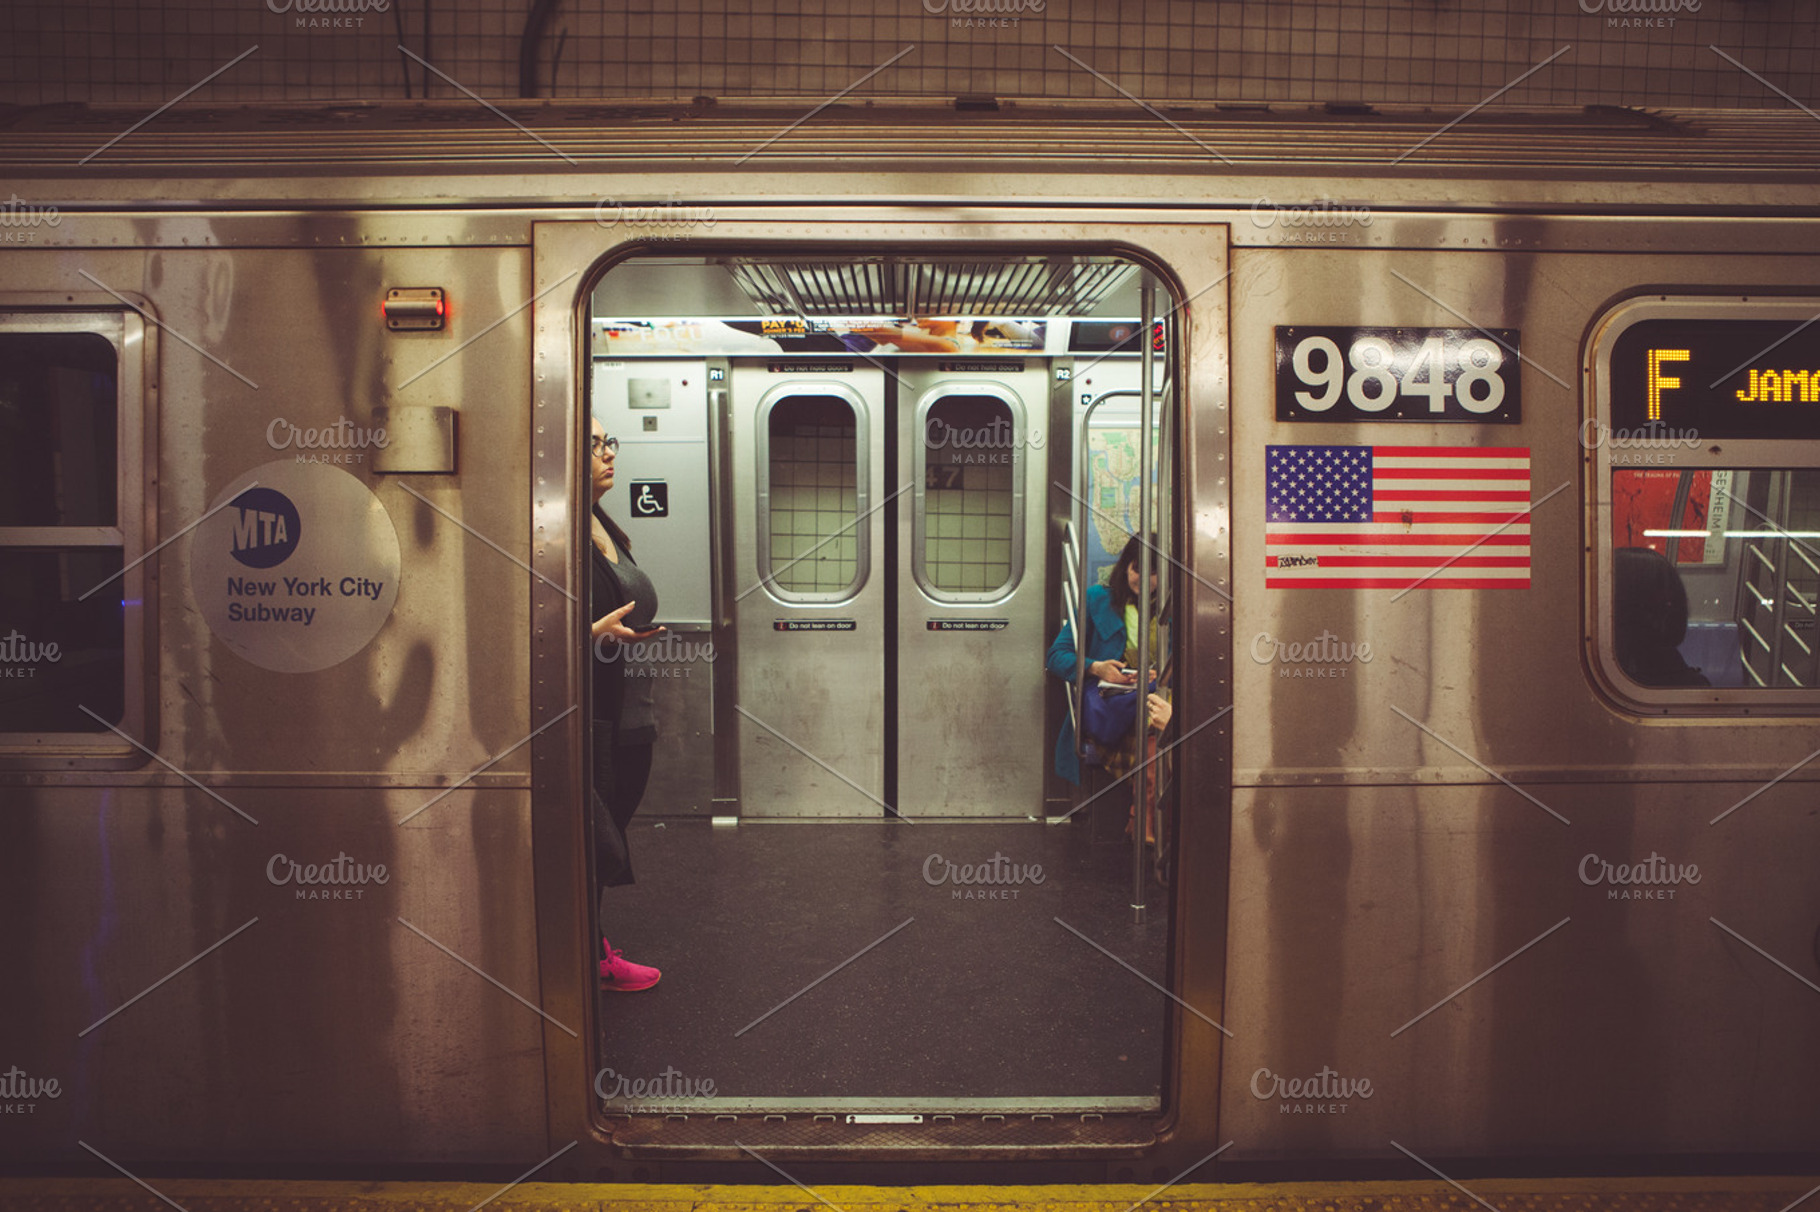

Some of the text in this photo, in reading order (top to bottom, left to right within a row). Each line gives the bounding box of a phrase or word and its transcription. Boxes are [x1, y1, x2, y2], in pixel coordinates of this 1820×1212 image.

[709, 369, 724, 380] R1
[1055, 369, 1071, 380] R2
[1293, 335, 1506, 415] 9848
[1647, 349, 1690, 421] F
[229, 504, 288, 552] MTA
[227, 576, 383, 601] New York City
[228, 603, 316, 626] Subway
[789, 622, 852, 630] Do not lean on door
